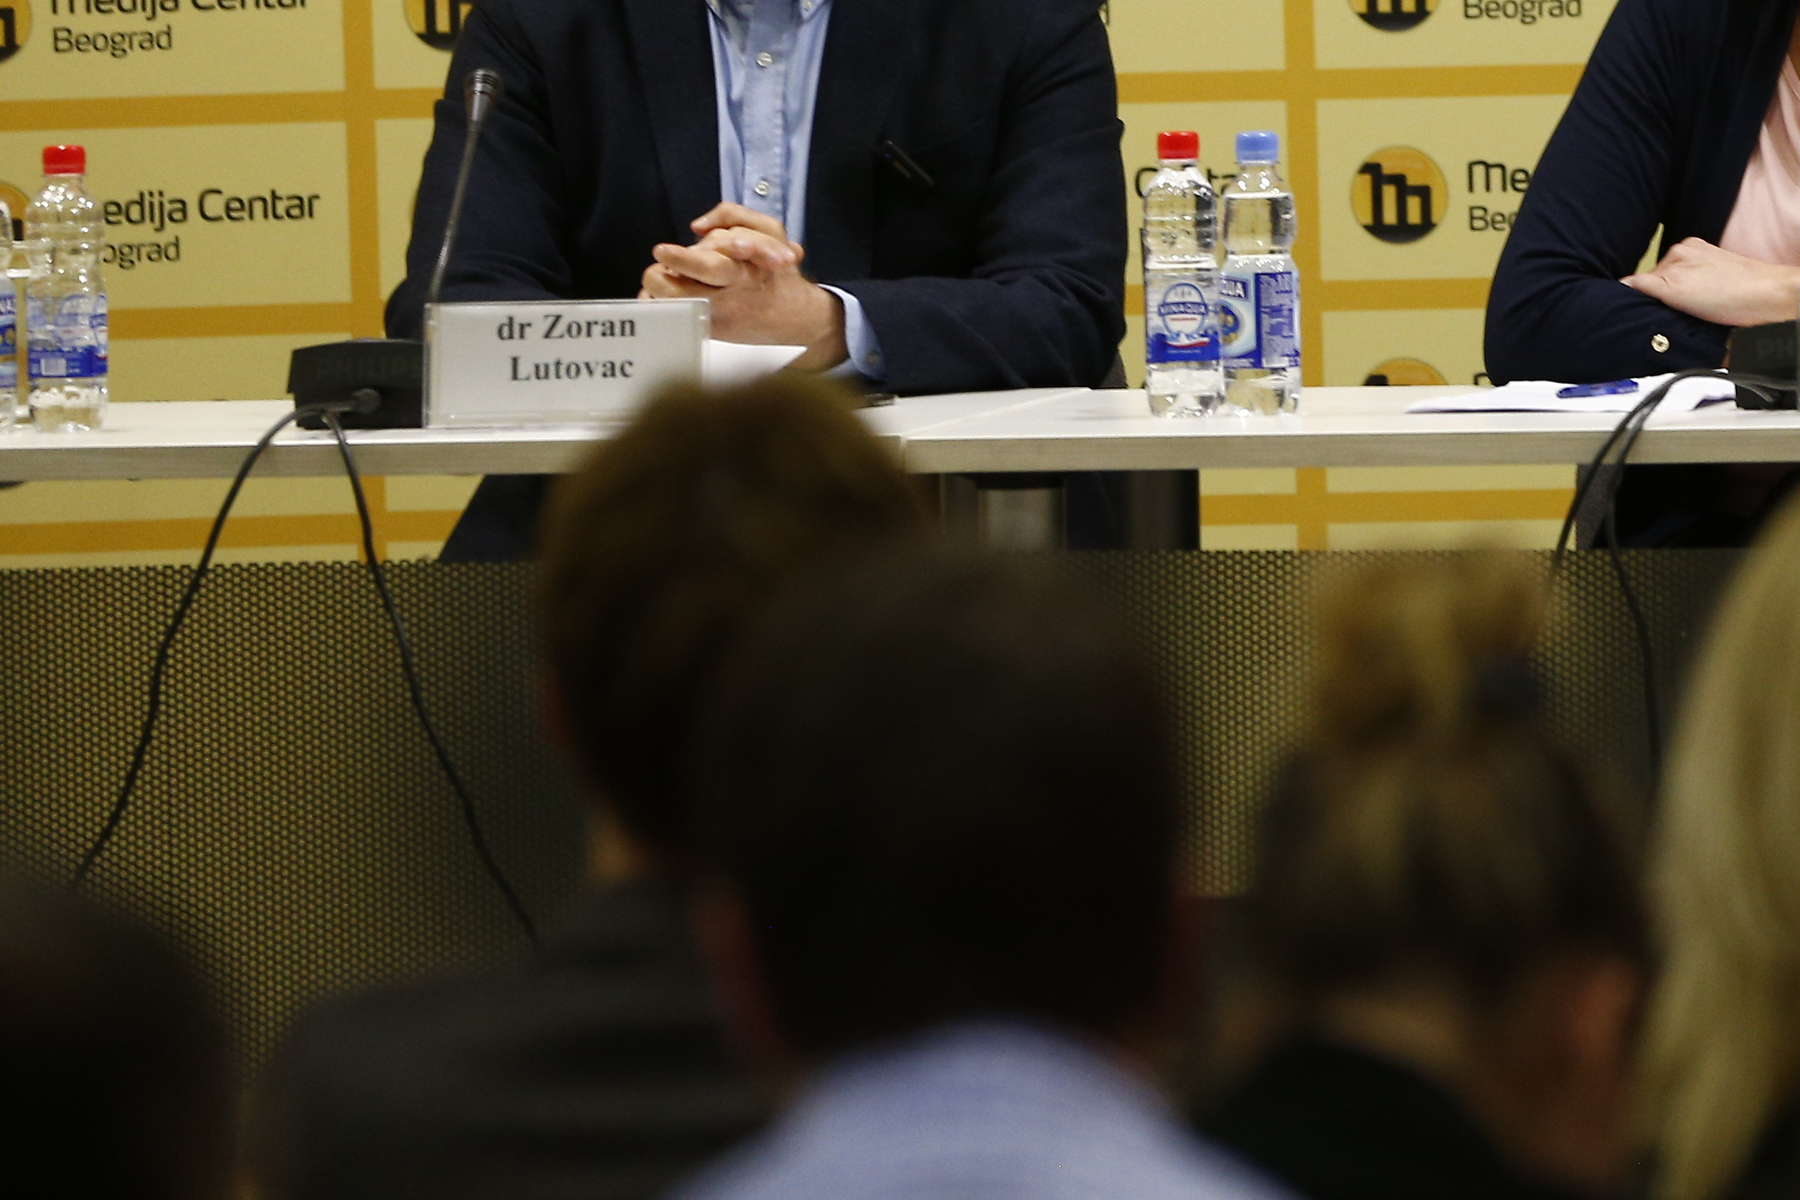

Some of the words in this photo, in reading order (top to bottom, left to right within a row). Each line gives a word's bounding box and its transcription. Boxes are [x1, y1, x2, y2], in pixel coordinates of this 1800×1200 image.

[52, 24, 172, 59] Beograd
[103, 191, 189, 232] edija
[199, 188, 321, 223] Centar
[102, 236, 181, 270] ograd
[497, 315, 533, 341] dr
[542, 313, 637, 340] Zoran
[510, 355, 635, 382] Lutovac
